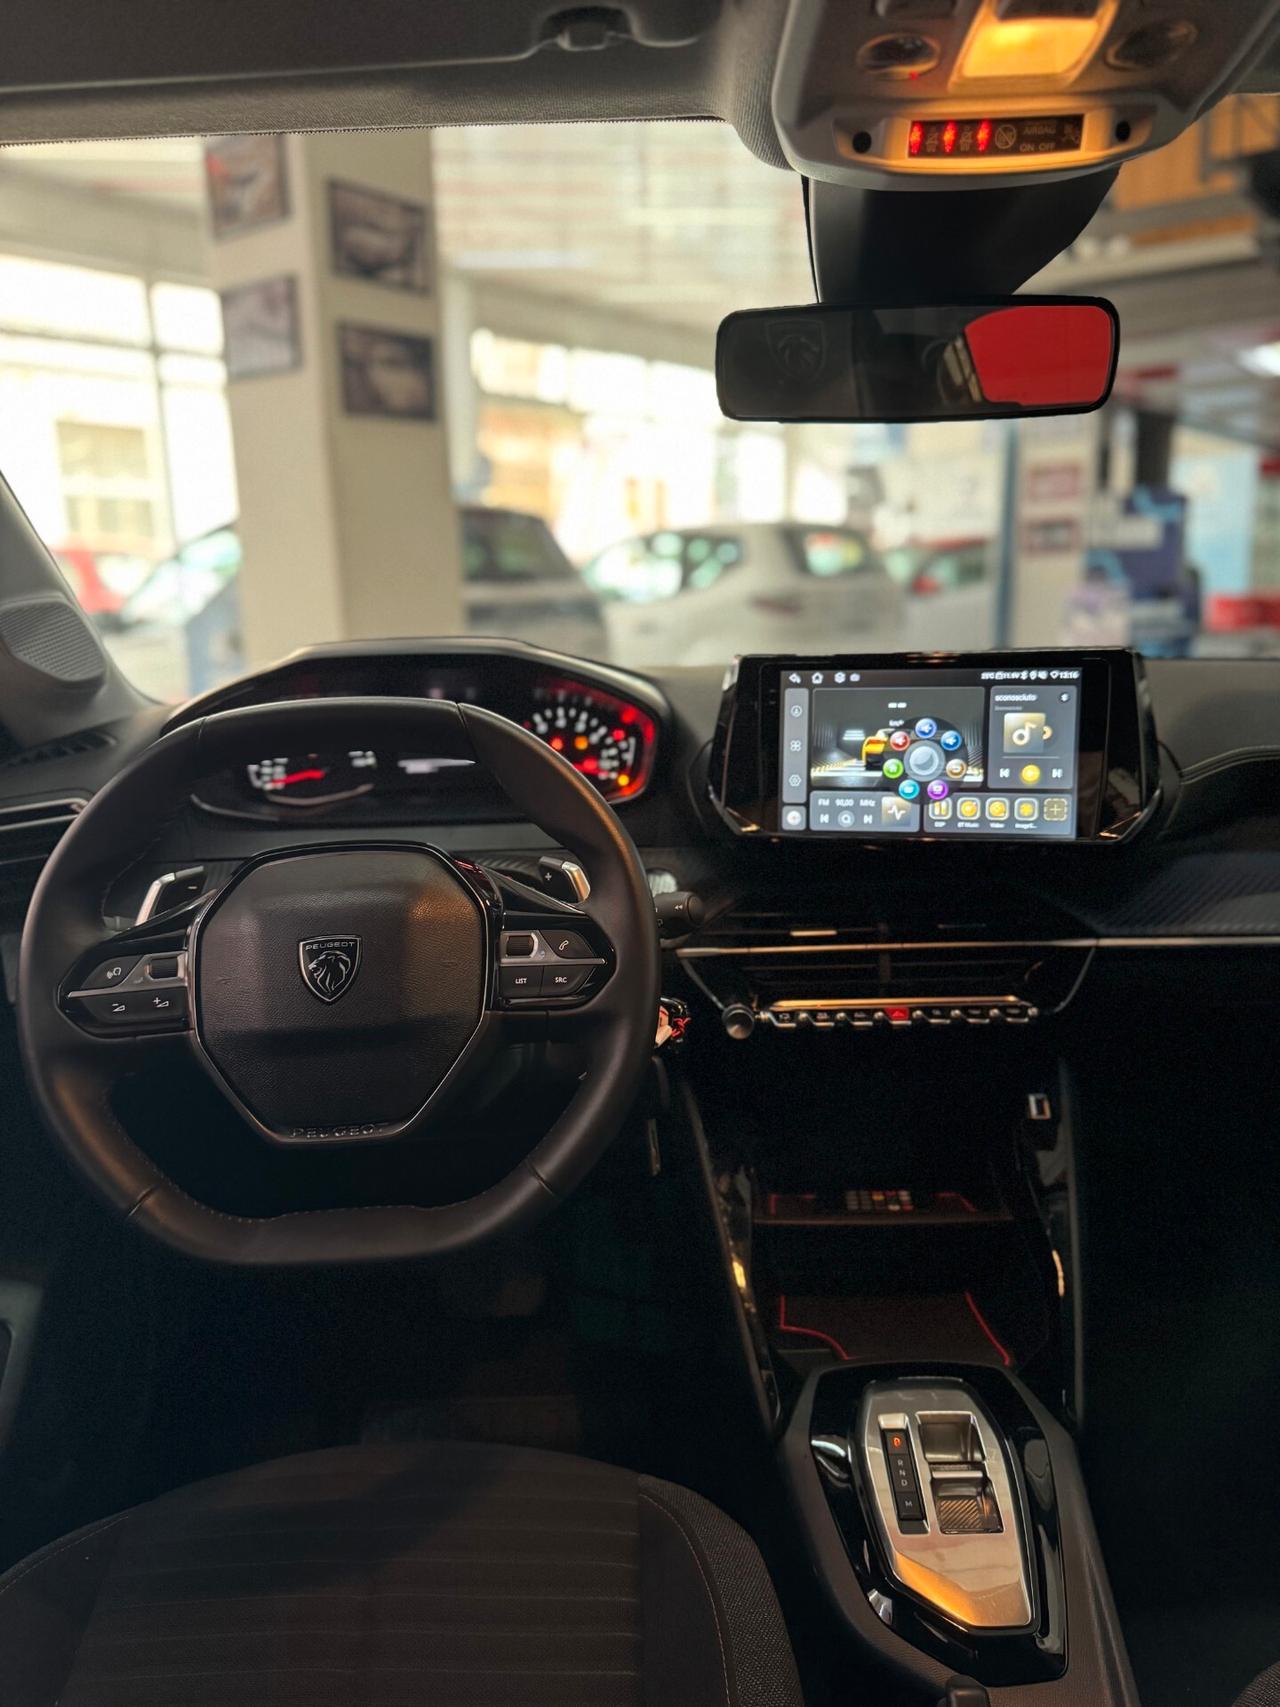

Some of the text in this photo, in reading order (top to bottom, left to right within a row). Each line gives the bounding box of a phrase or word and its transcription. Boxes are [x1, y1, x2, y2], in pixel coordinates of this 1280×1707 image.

[1019, 142, 1056, 152] ON OFF
[818, 798, 830, 806] FM
[859, 799, 876, 807] MHz
[305, 941, 356, 951] PEUGEOT
[515, 977, 528, 985] LIST
[555, 976, 567, 984] SRC
[905, 1500, 913, 1508] M
